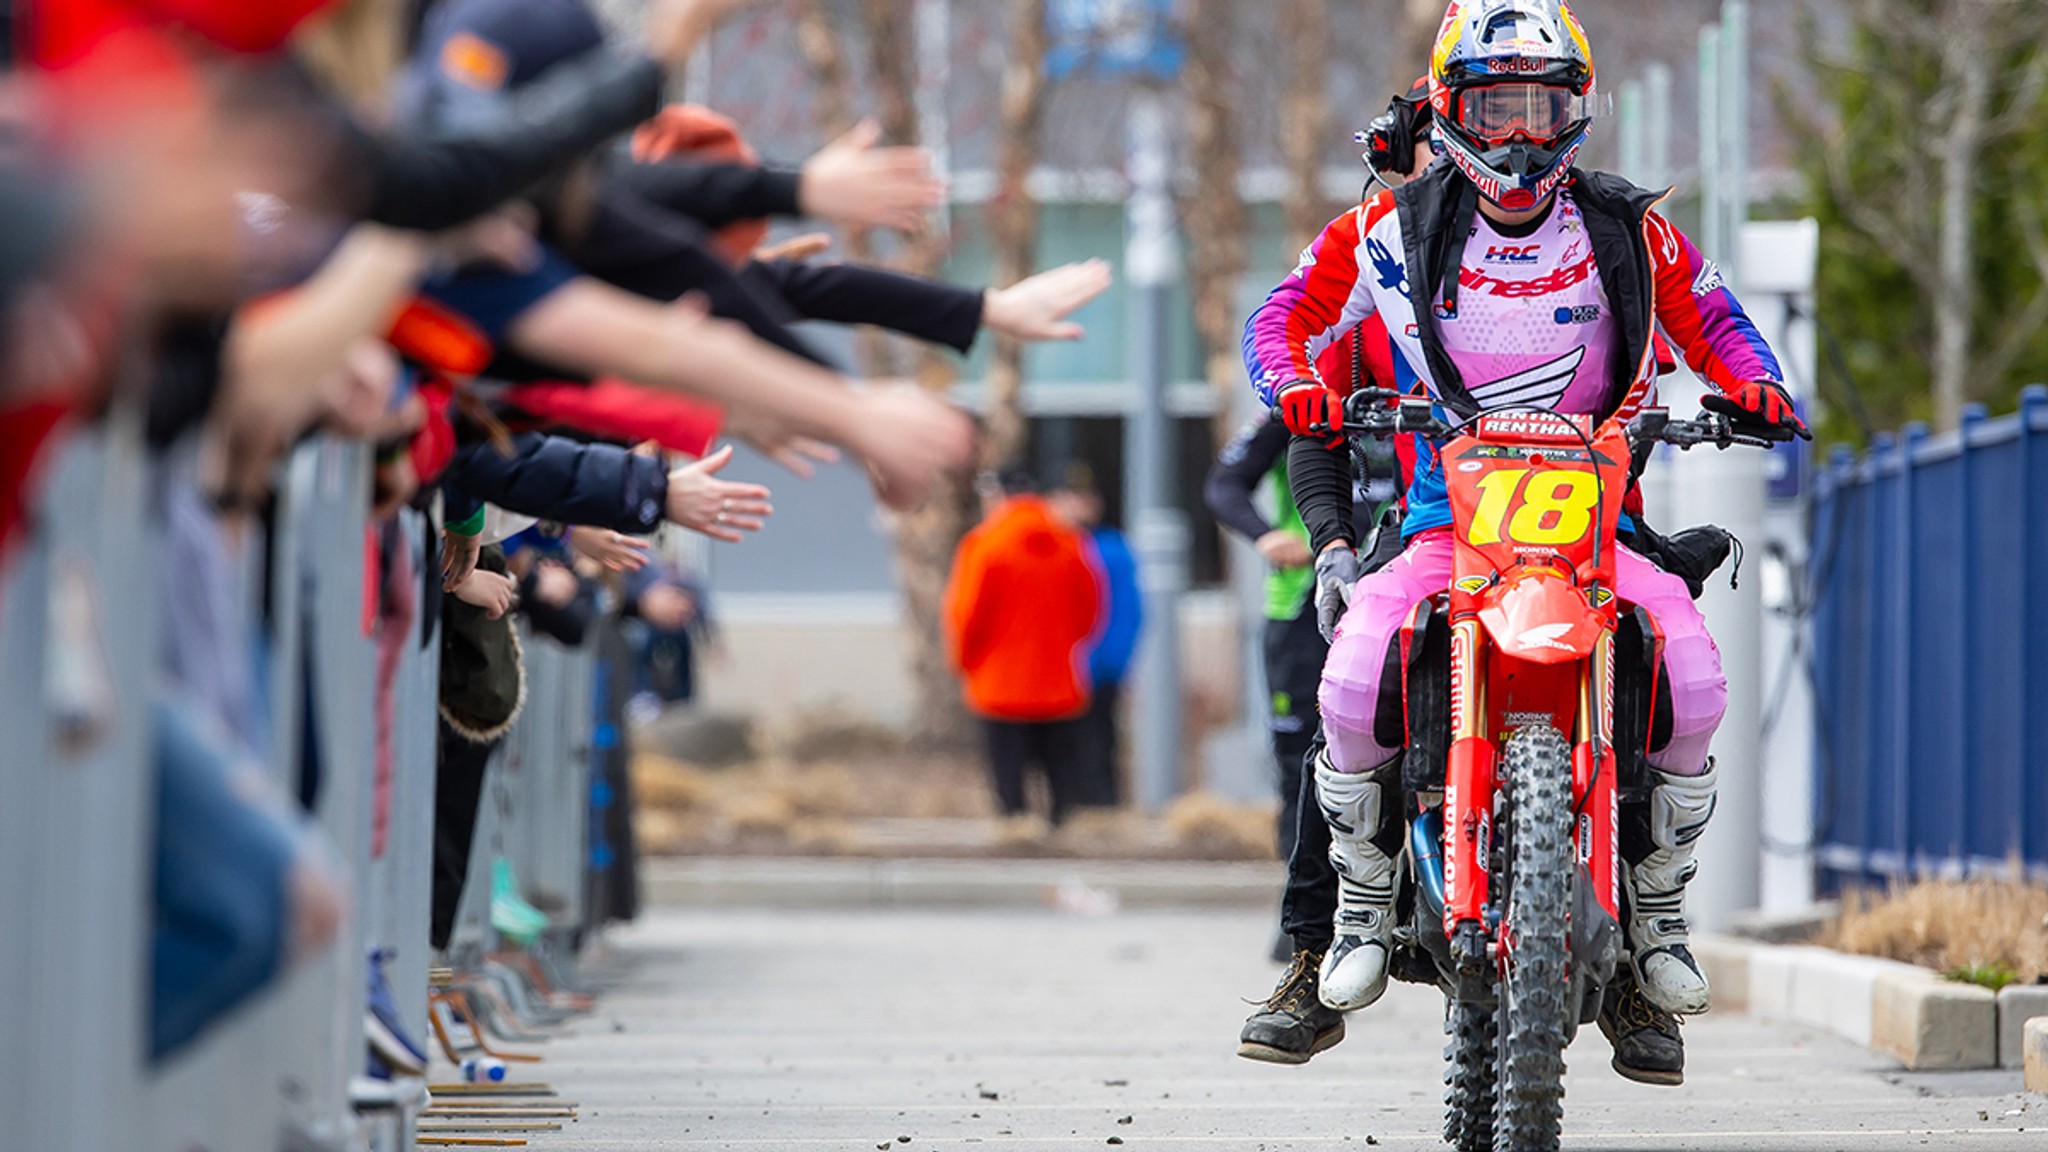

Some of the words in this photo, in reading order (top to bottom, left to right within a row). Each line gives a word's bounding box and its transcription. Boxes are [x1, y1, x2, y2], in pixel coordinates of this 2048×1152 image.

[1488, 58, 1517, 73] Red
[1519, 57, 1547, 72] Bull
[1484, 245, 1541, 261] HRC
[1468, 469, 1605, 546] 18
[1513, 546, 1559, 556] HONDA
[1445, 785, 1457, 901] DUNLOP
[1610, 788, 1619, 909] DUNLOP
